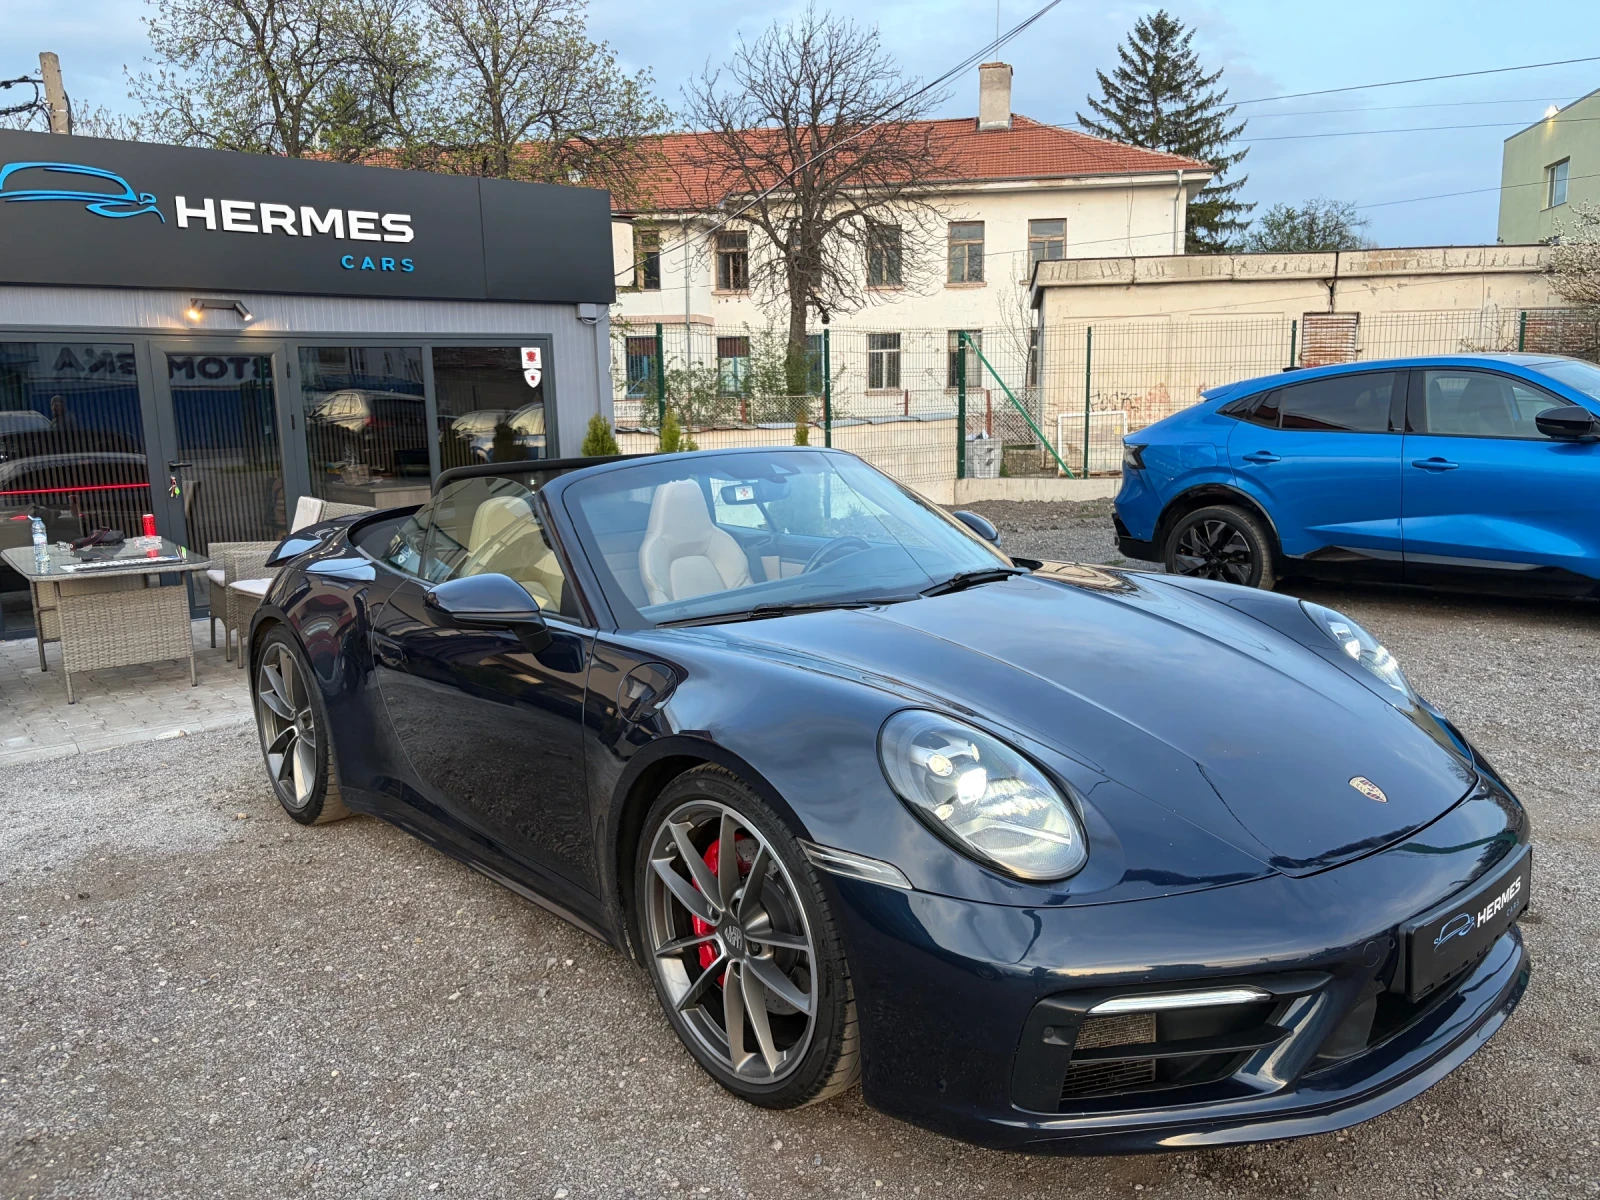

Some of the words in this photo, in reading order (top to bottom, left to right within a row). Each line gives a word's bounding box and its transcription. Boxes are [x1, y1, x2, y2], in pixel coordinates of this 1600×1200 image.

[175, 195, 414, 243] HERMES
[341, 255, 414, 272] CARS
[1477, 876, 1521, 928] HERMES
[1506, 898, 1520, 917] CARS
